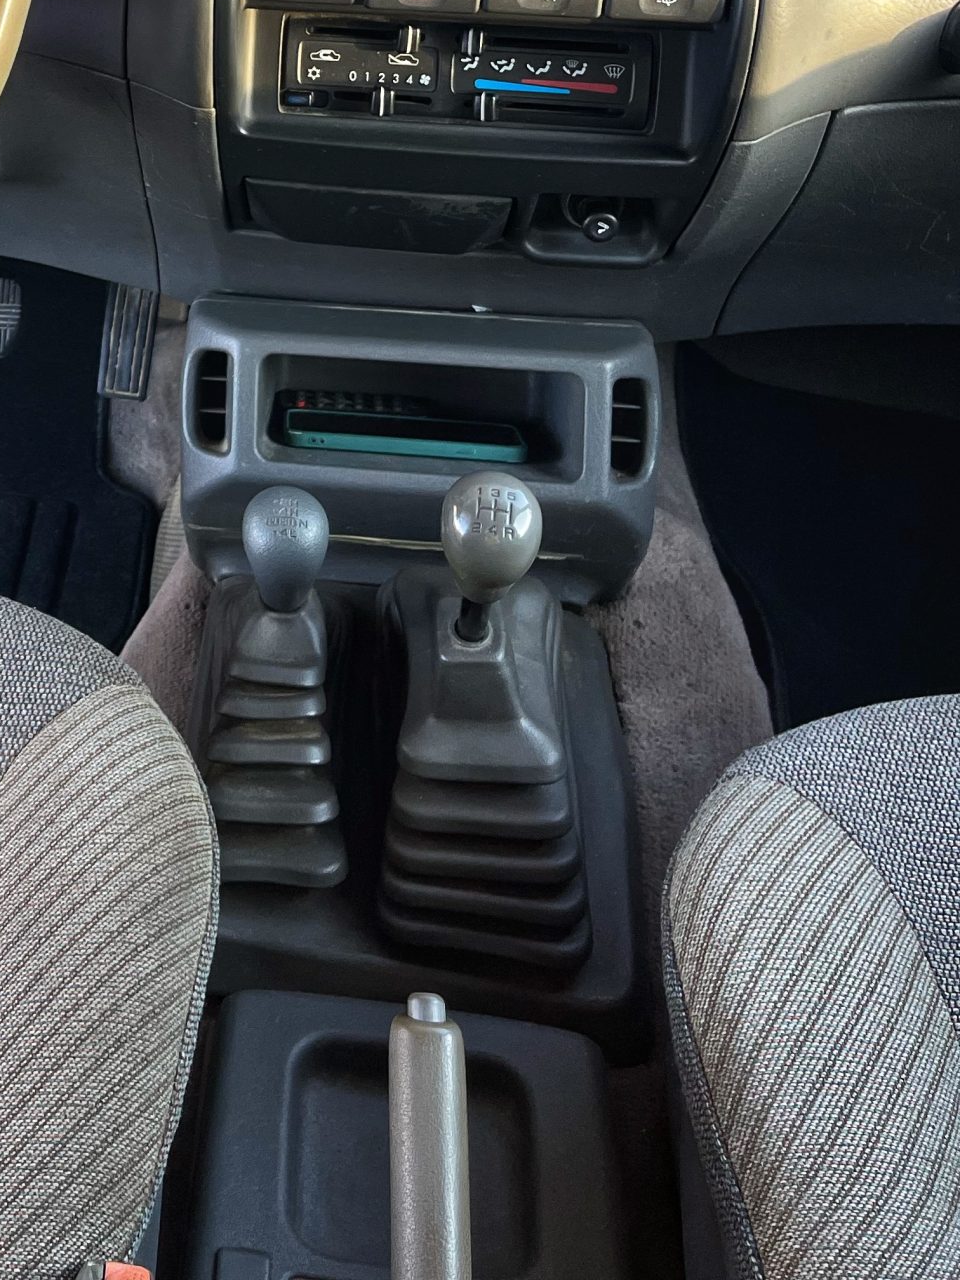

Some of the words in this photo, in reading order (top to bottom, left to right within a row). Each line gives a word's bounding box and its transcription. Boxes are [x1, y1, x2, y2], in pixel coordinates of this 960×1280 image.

[349, 71, 357, 81] 0
[365, 72, 370, 82] 1
[378, 73, 386, 83] 2
[392, 73, 400, 84] 3
[406, 74, 413, 85] 4
[491, 488, 500, 498] 3
[507, 491, 516, 501] 5
[298, 519, 308, 529] N
[472, 521, 482, 533] 2
[489, 524, 497, 535] 4
[503, 526, 514, 540] R
